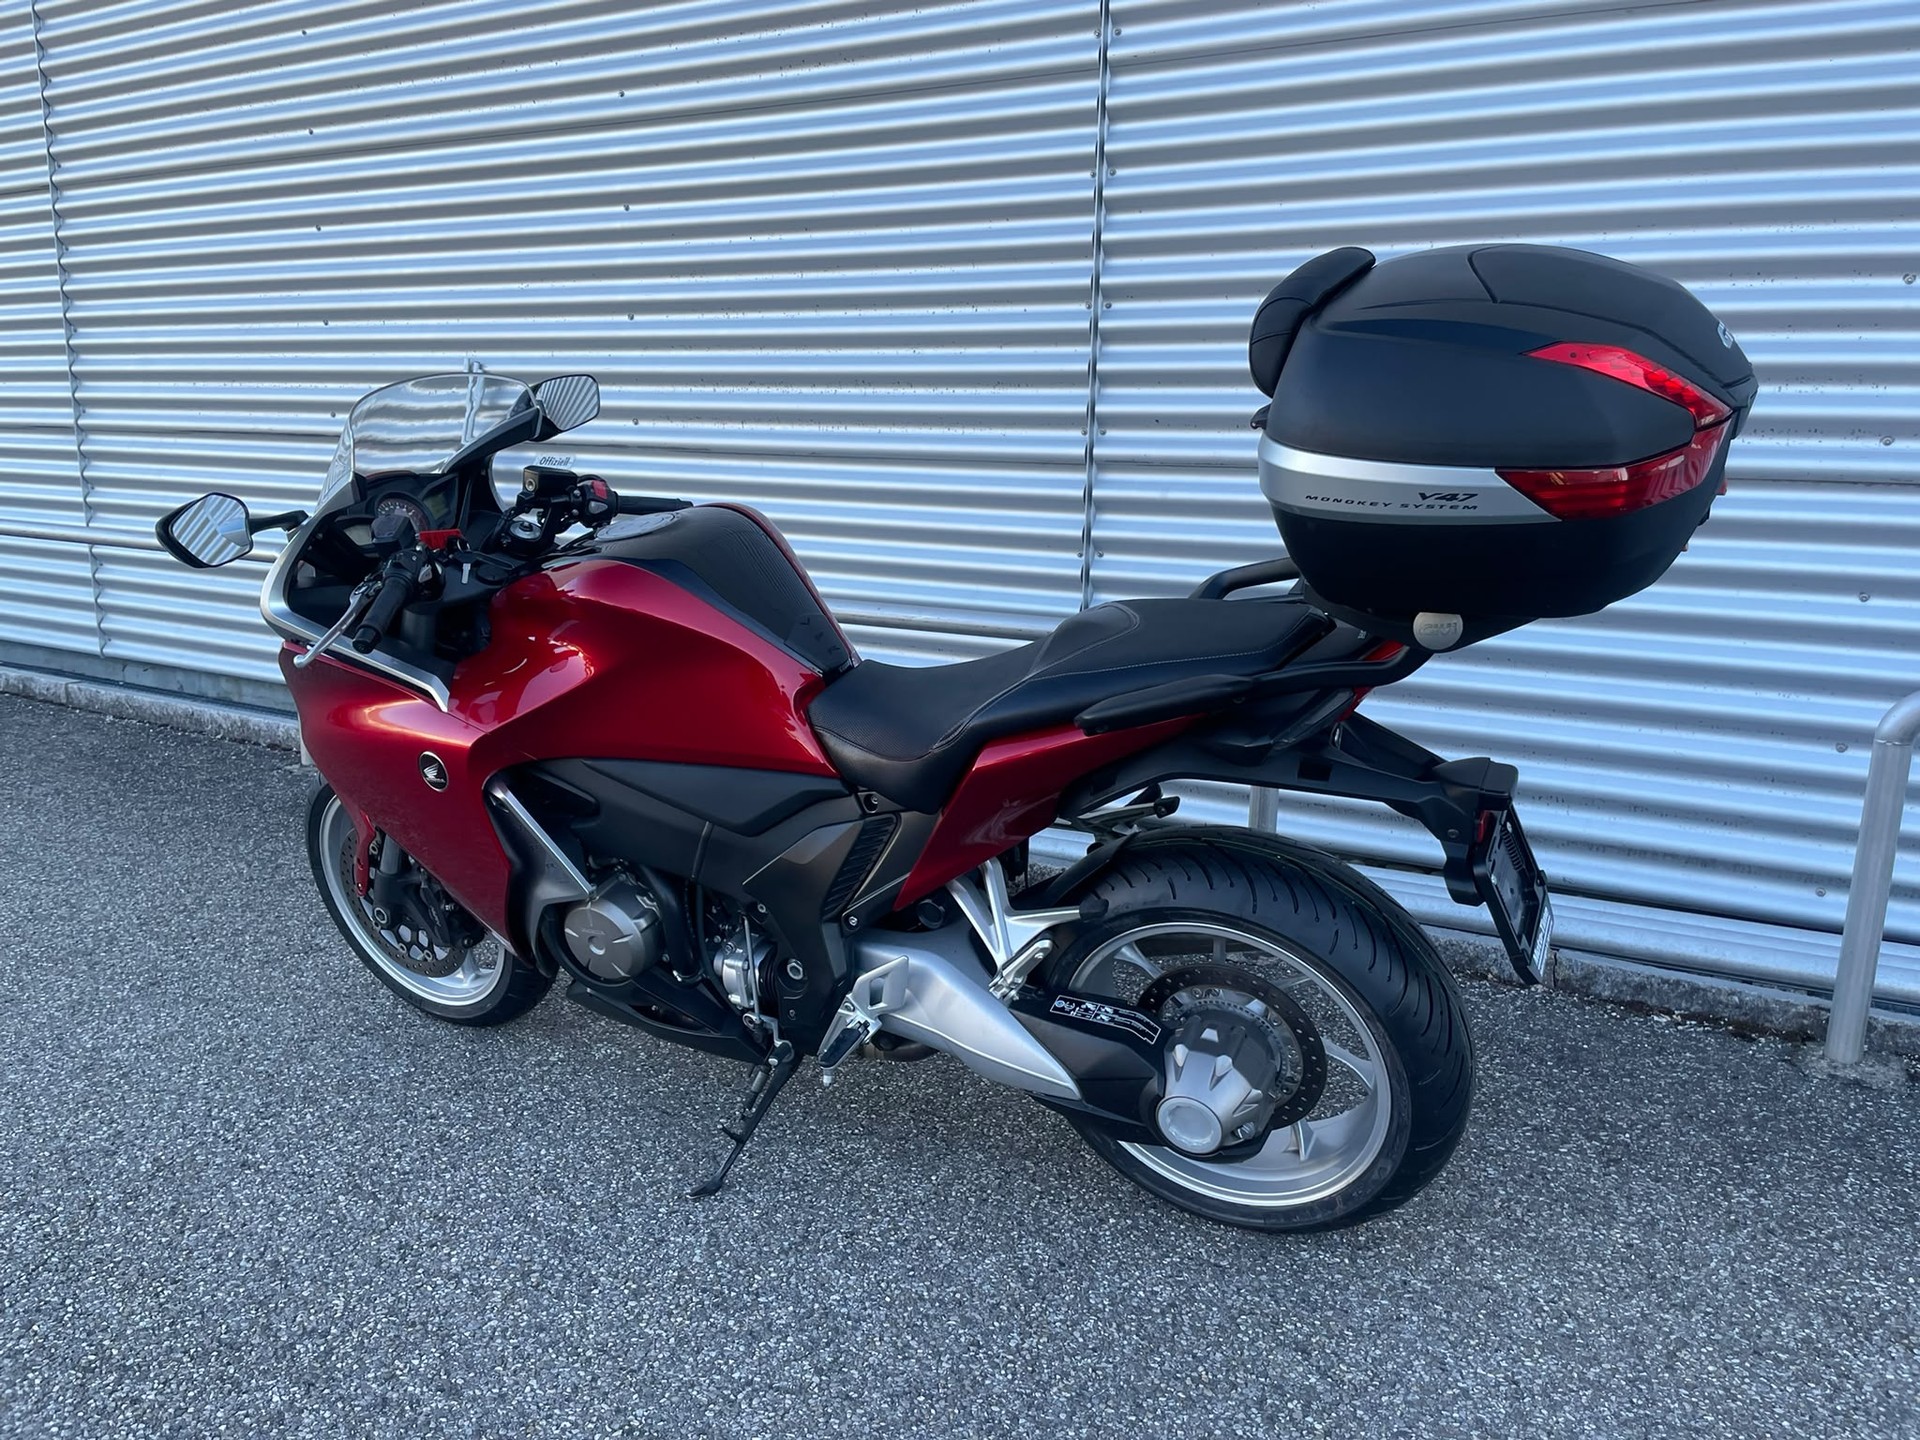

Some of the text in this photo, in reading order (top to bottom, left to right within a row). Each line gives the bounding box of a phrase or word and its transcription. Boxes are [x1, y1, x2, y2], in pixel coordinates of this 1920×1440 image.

[1305, 495, 1478, 511] MONOKEY SYSTEM
[1418, 491, 1479, 503] V47
